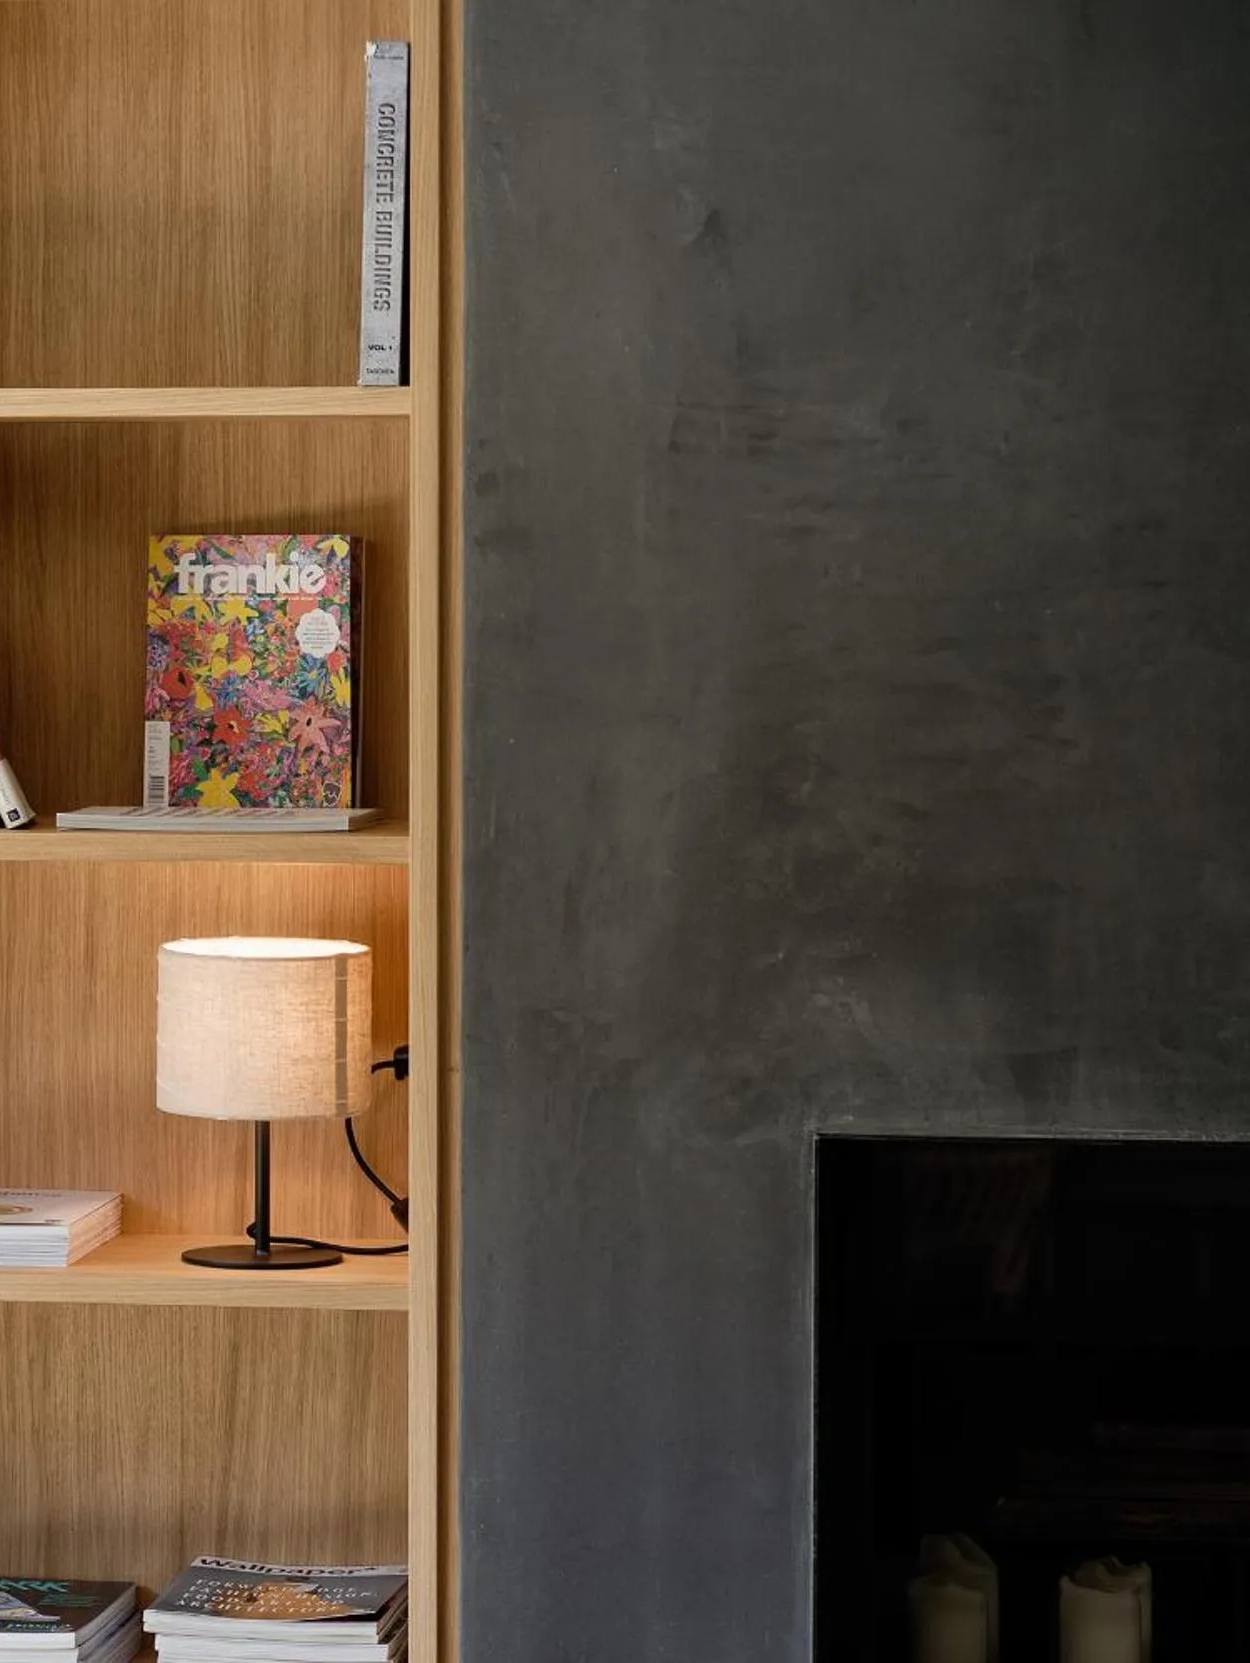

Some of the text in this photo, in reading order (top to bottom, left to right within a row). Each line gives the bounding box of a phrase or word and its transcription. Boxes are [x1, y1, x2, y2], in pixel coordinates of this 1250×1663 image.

[373, 103, 396, 312] CONCRETE BUILDINGS
[174, 551, 327, 595] frankie
